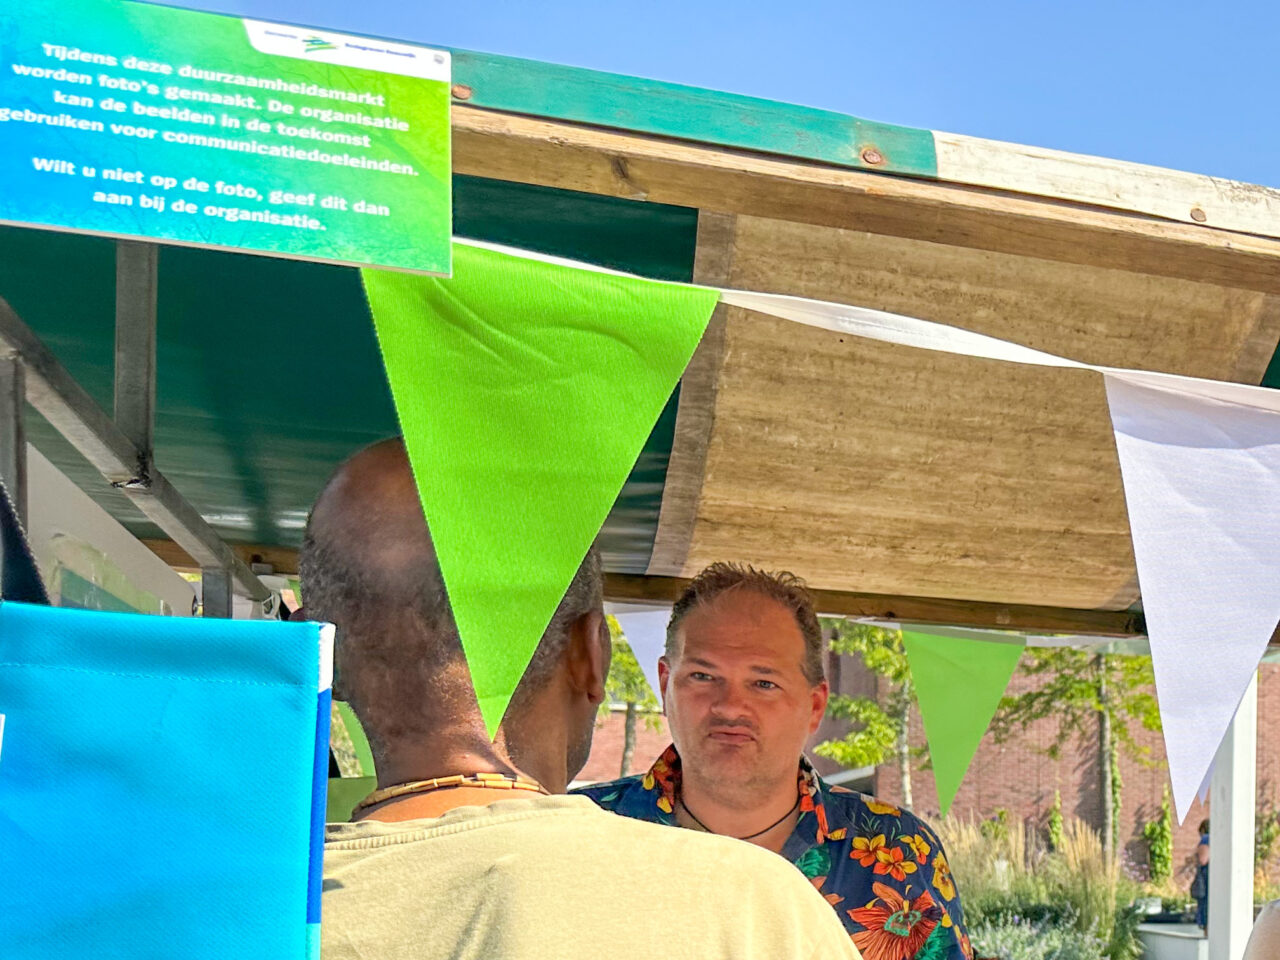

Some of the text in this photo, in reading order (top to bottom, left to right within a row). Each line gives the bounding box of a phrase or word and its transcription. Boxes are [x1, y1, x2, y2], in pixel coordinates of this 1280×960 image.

[12, 63, 410, 132] worden foto's gemaakt. De organisatie
[42, 42, 386, 107] Tijdens deze duurzaamheidsmarkt
[0, 107, 419, 177] gebruiken voor communicatiedoeleinden.
[53, 90, 371, 148] kan de beelden in de toekomst
[32, 157, 390, 217] Wilt u niet op de foto, geef dit dan
[93, 191, 327, 231] aan bij de organisatie.
